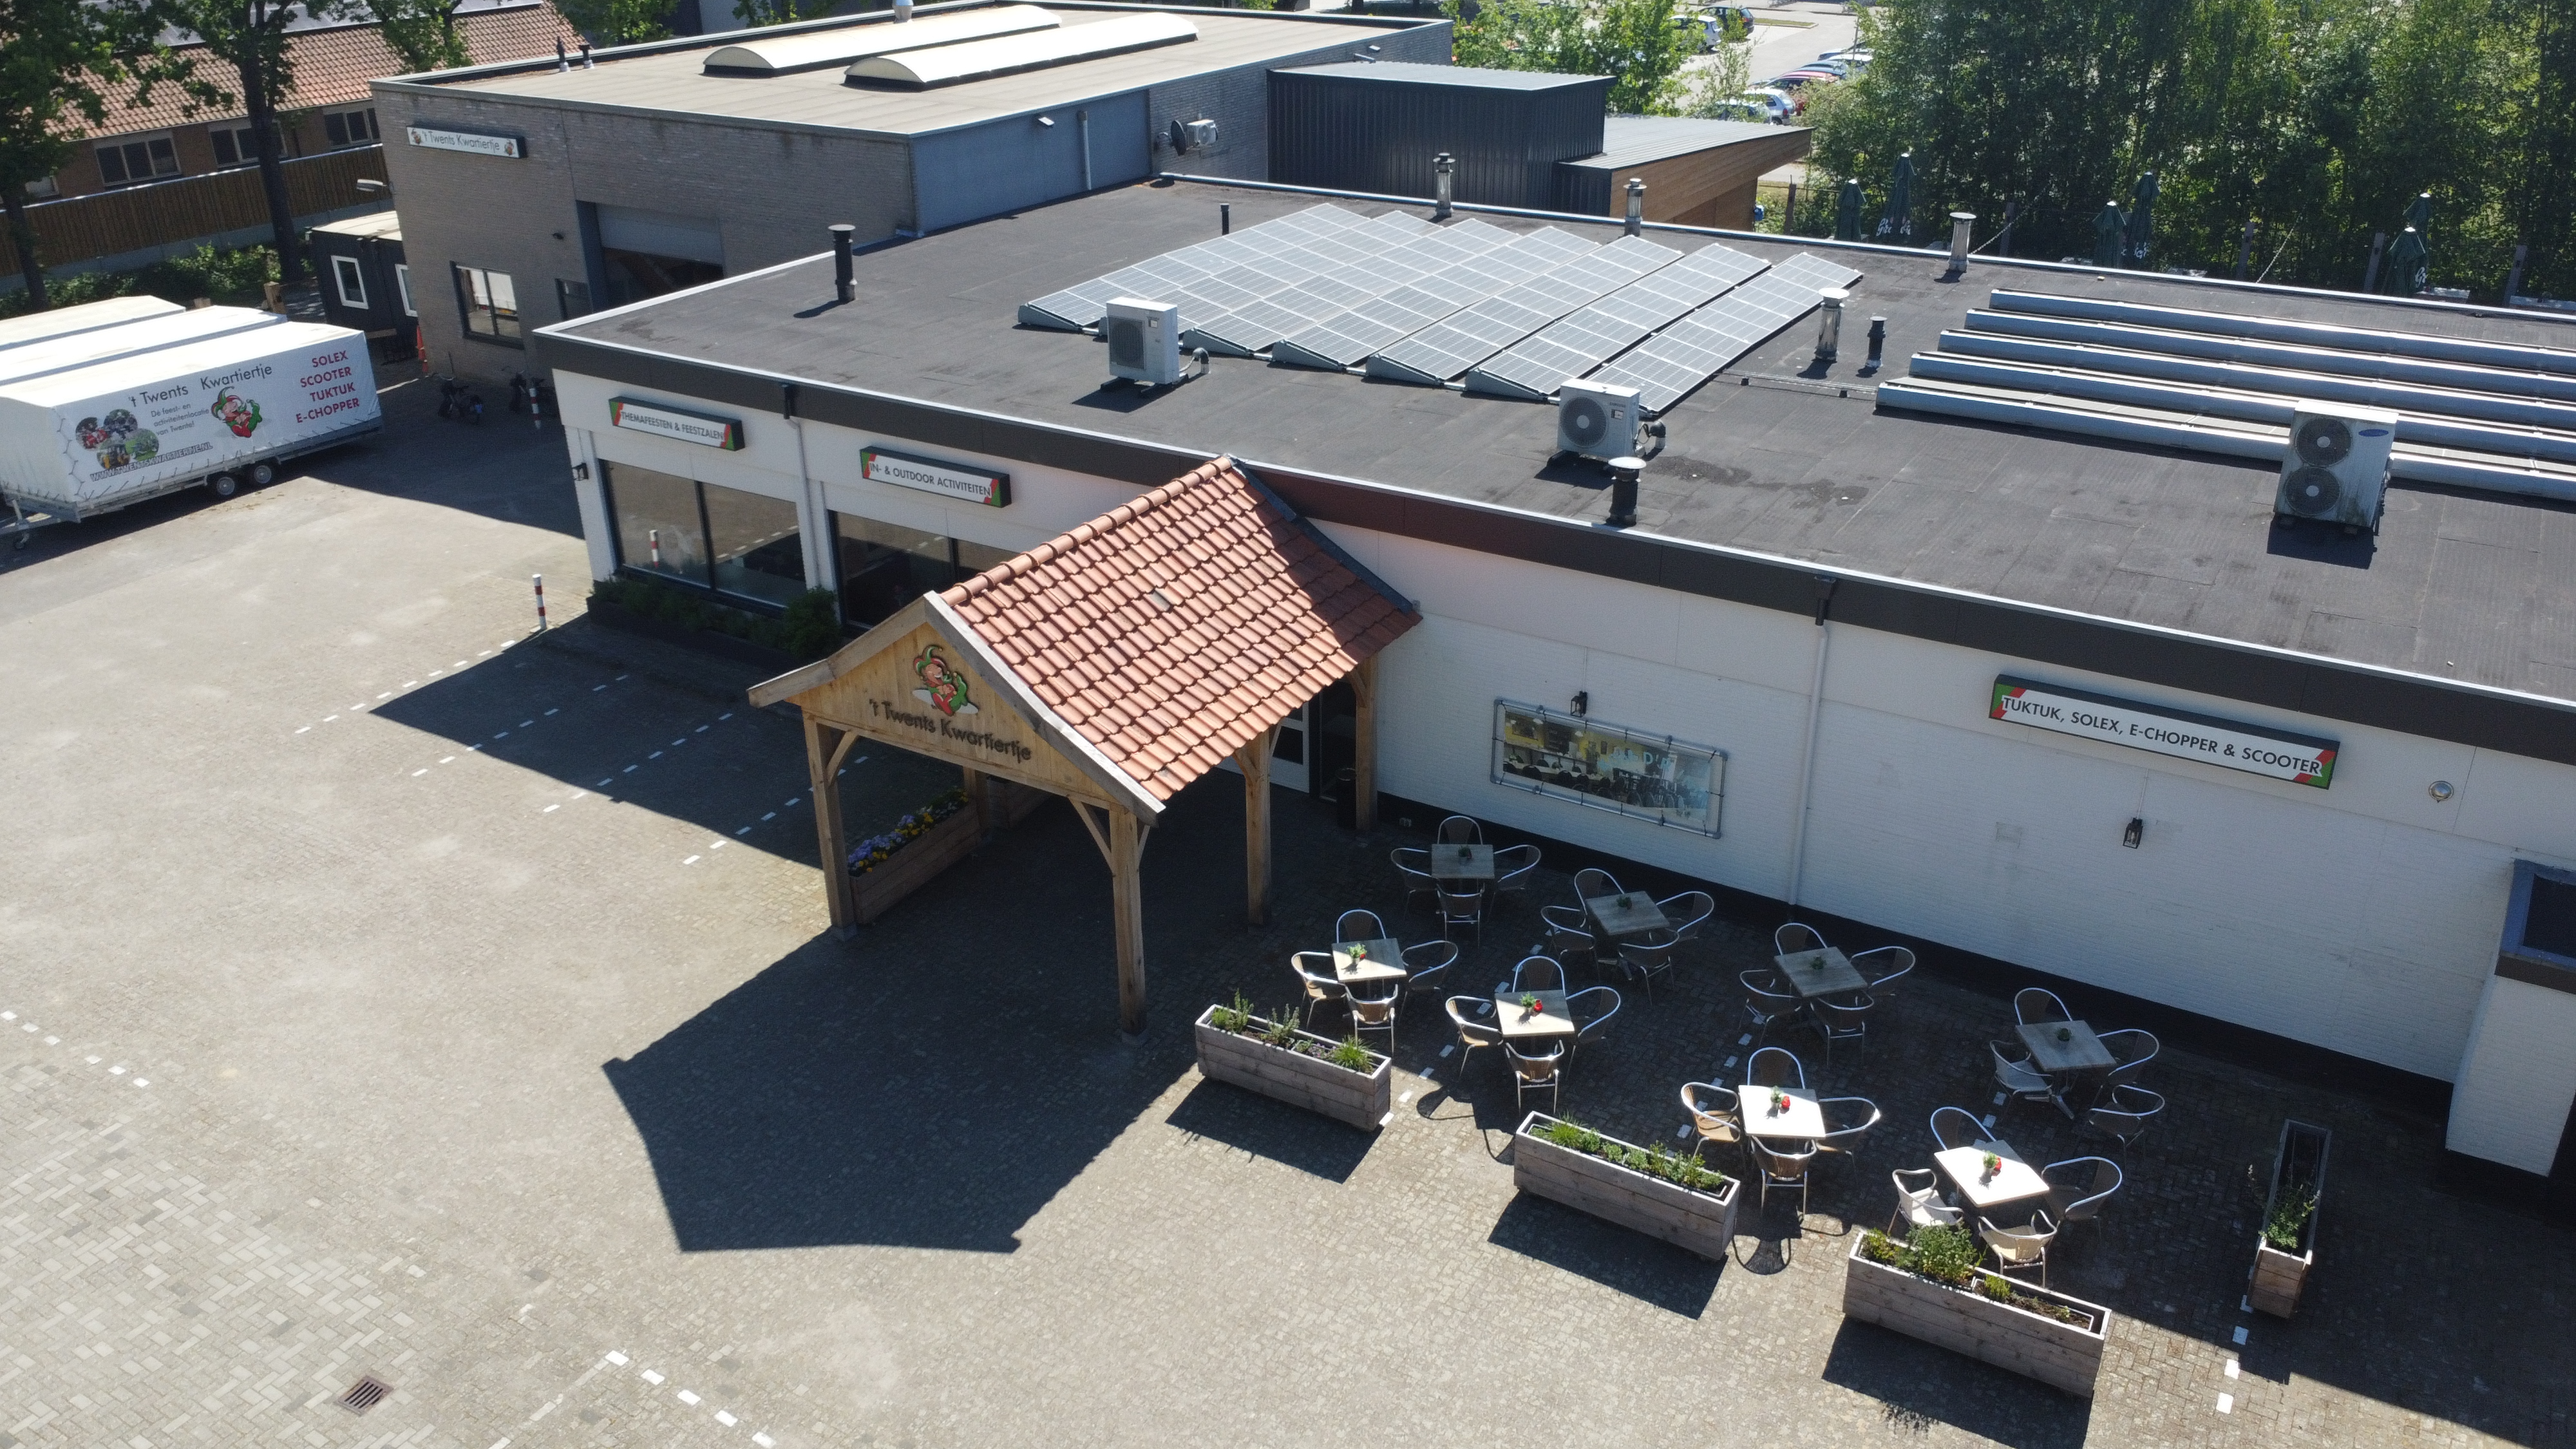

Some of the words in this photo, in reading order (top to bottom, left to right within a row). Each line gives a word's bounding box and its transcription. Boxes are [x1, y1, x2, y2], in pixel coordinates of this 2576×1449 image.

[428, 131, 455, 146] Twents
[456, 134, 500, 153] Kwartiertje
[312, 350, 348, 368] SOLEX
[140, 385, 189, 404] Twents
[200, 364, 272, 390] Kwartiertje
[300, 366, 352, 388] SCOOTER
[309, 382, 356, 402] TUKTUK
[296, 397, 360, 423] E-CHOPPER
[621, 411, 673, 430] THEMAFEESTEN
[674, 422, 681, 431] &
[681, 424, 724, 440] FEESTZALEN
[869, 462, 882, 472] IN-
[884, 466, 891, 475] &
[893, 468, 935, 484] OUTDOOR
[937, 477, 992, 497] ACTIVITEITEN
[881, 700, 936, 734] Twents
[940, 718, 1033, 764] Kwartiertje
[2003, 697, 2065, 723] TUKTUK,
[2070, 712, 2123, 735] SOLEX,
[2129, 724, 2218, 753] E-CHOPPER
[2223, 743, 2236, 757] &
[2242, 747, 2322, 775] SCOOTER
